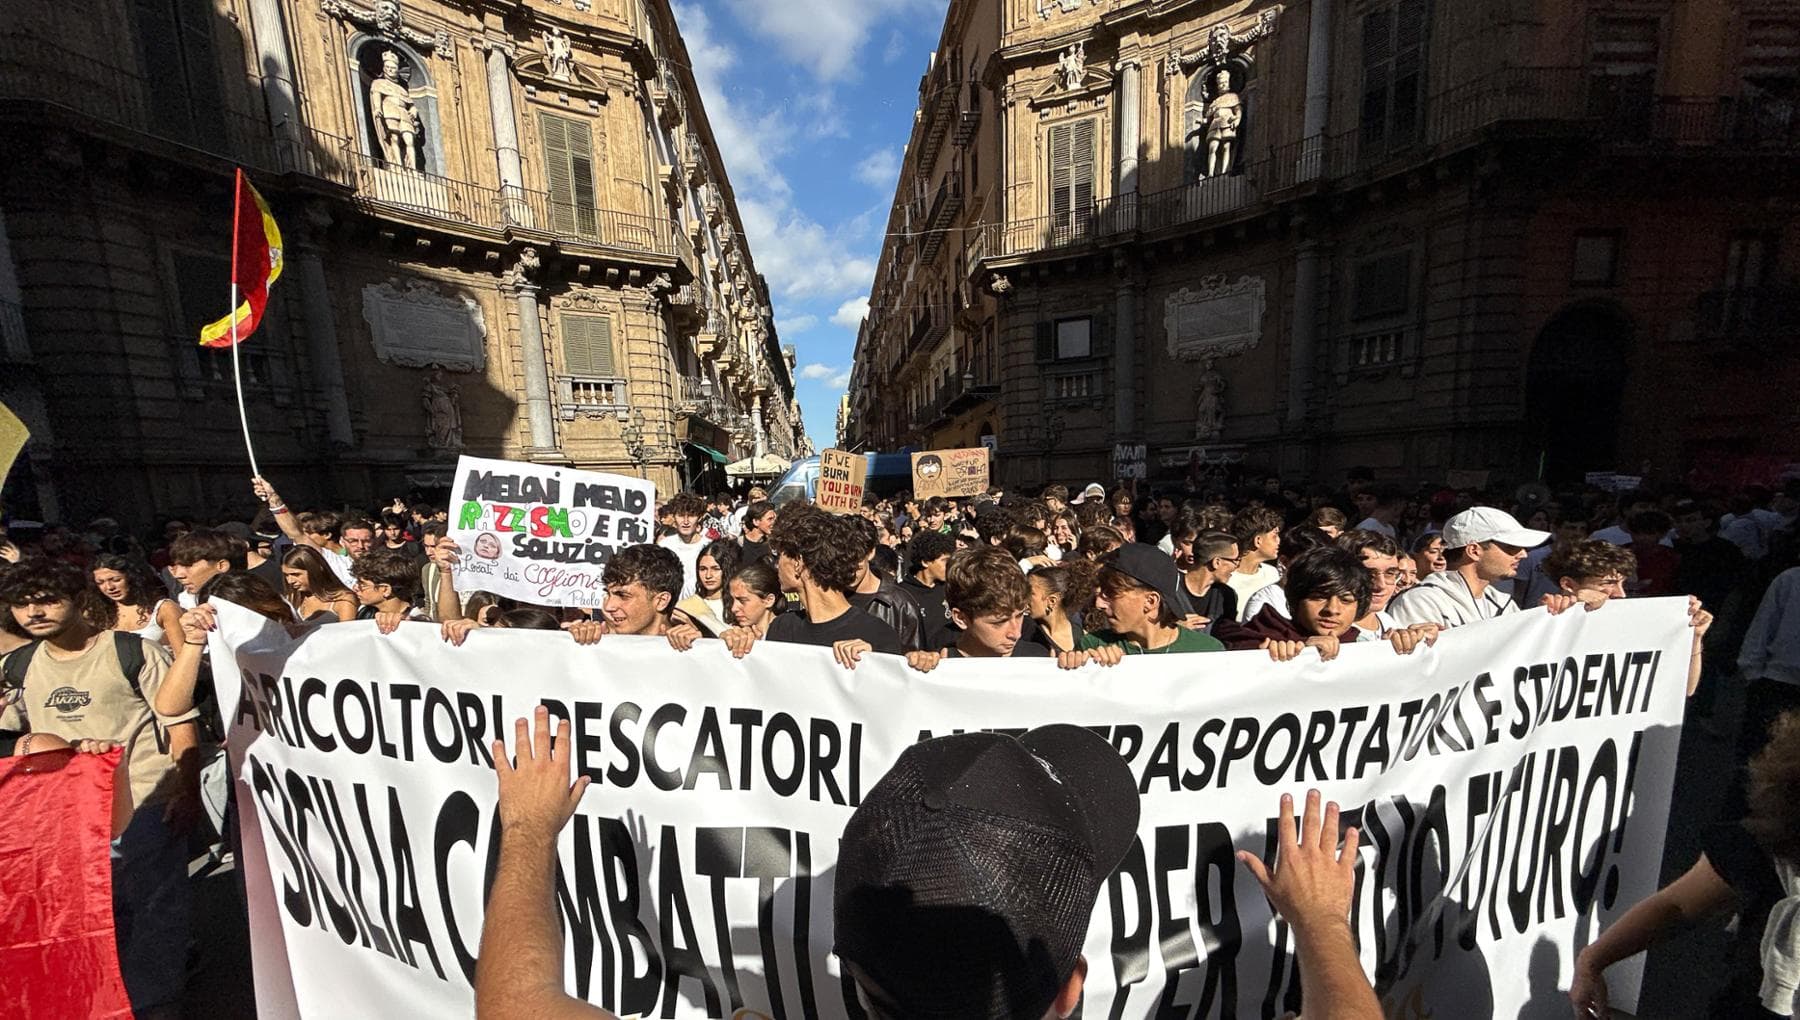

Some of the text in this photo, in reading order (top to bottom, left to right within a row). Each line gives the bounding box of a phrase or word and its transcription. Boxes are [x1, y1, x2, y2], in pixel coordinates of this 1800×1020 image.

[824, 452, 850, 468] IF WE
[823, 466, 849, 481] BURN
[822, 479, 862, 497] YOU BURN
[573, 482, 646, 515] MENO
[820, 493, 858, 510] WITH US
[591, 515, 610, 538] E
[1473, 672, 1502, 745] E
[250, 753, 449, 972] SICILIA
[434, 790, 823, 1020] CMBATTI
[1106, 822, 1242, 1020] PER
[1457, 730, 1644, 950] FUTURO!
